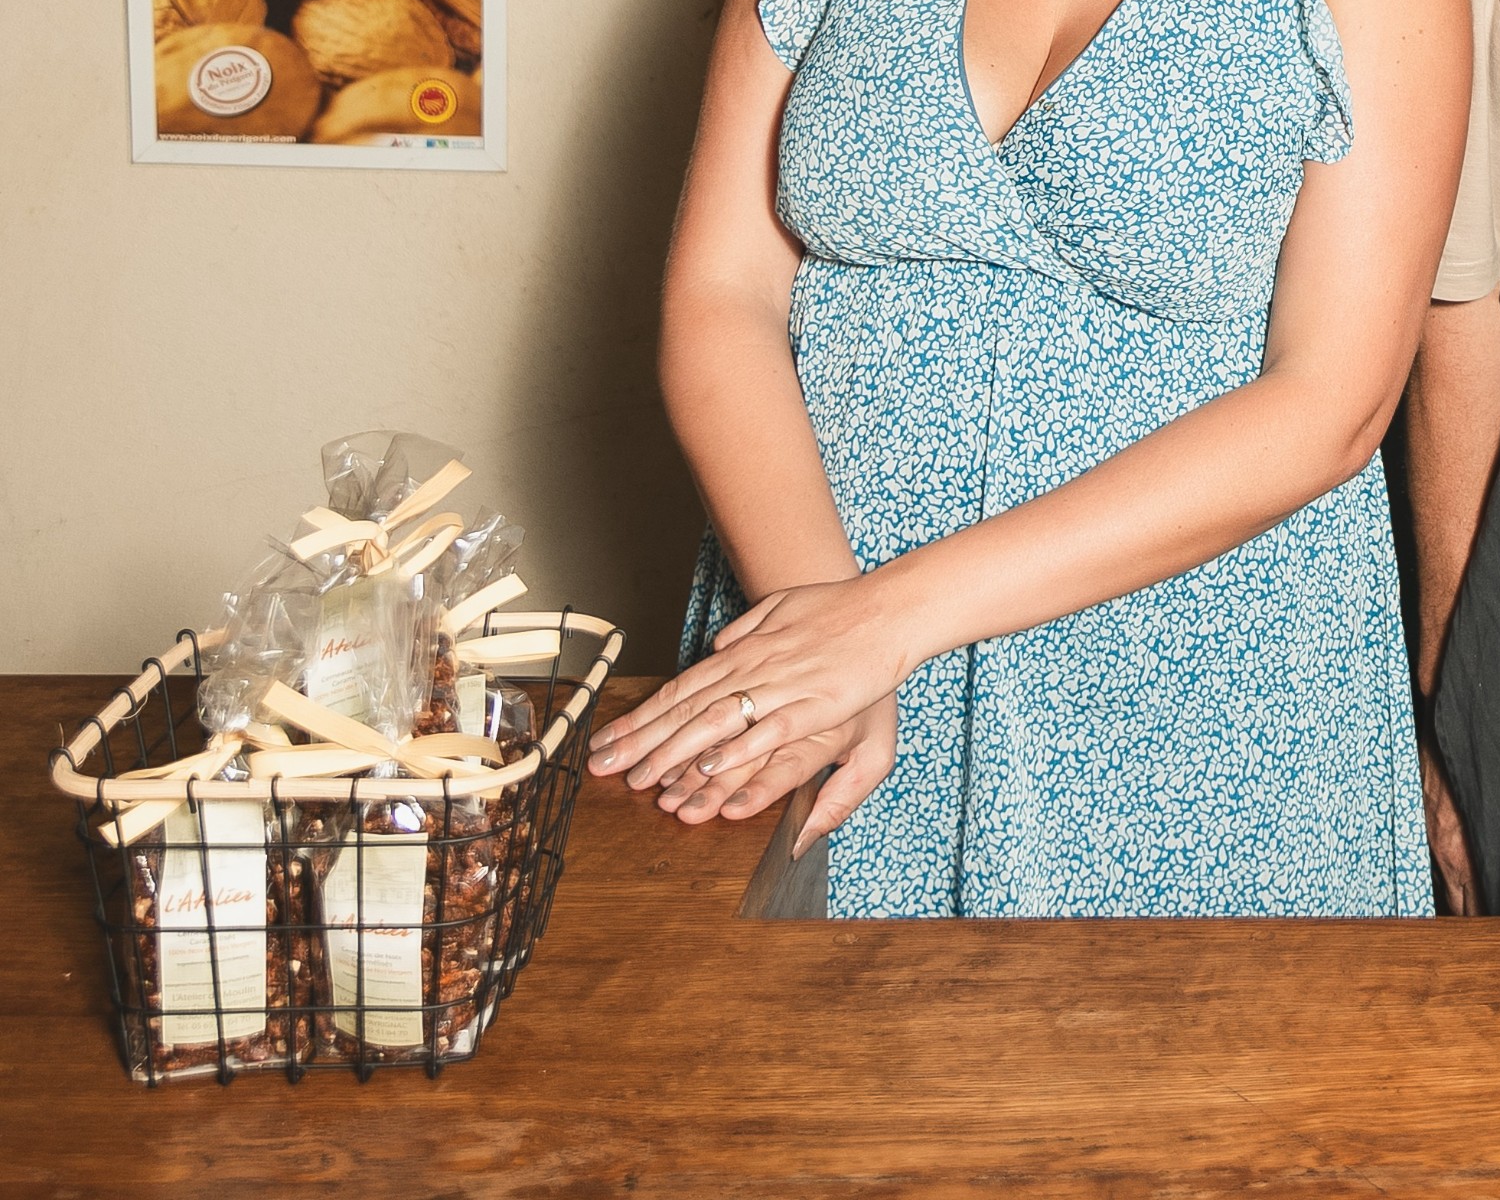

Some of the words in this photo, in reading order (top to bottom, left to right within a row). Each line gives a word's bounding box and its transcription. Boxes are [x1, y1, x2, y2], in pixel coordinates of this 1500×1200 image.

[207, 62, 248, 81] Noix
[159, 132, 297, 144] www.noixduperigord.com
[164, 887, 255, 913] L'Atlier
